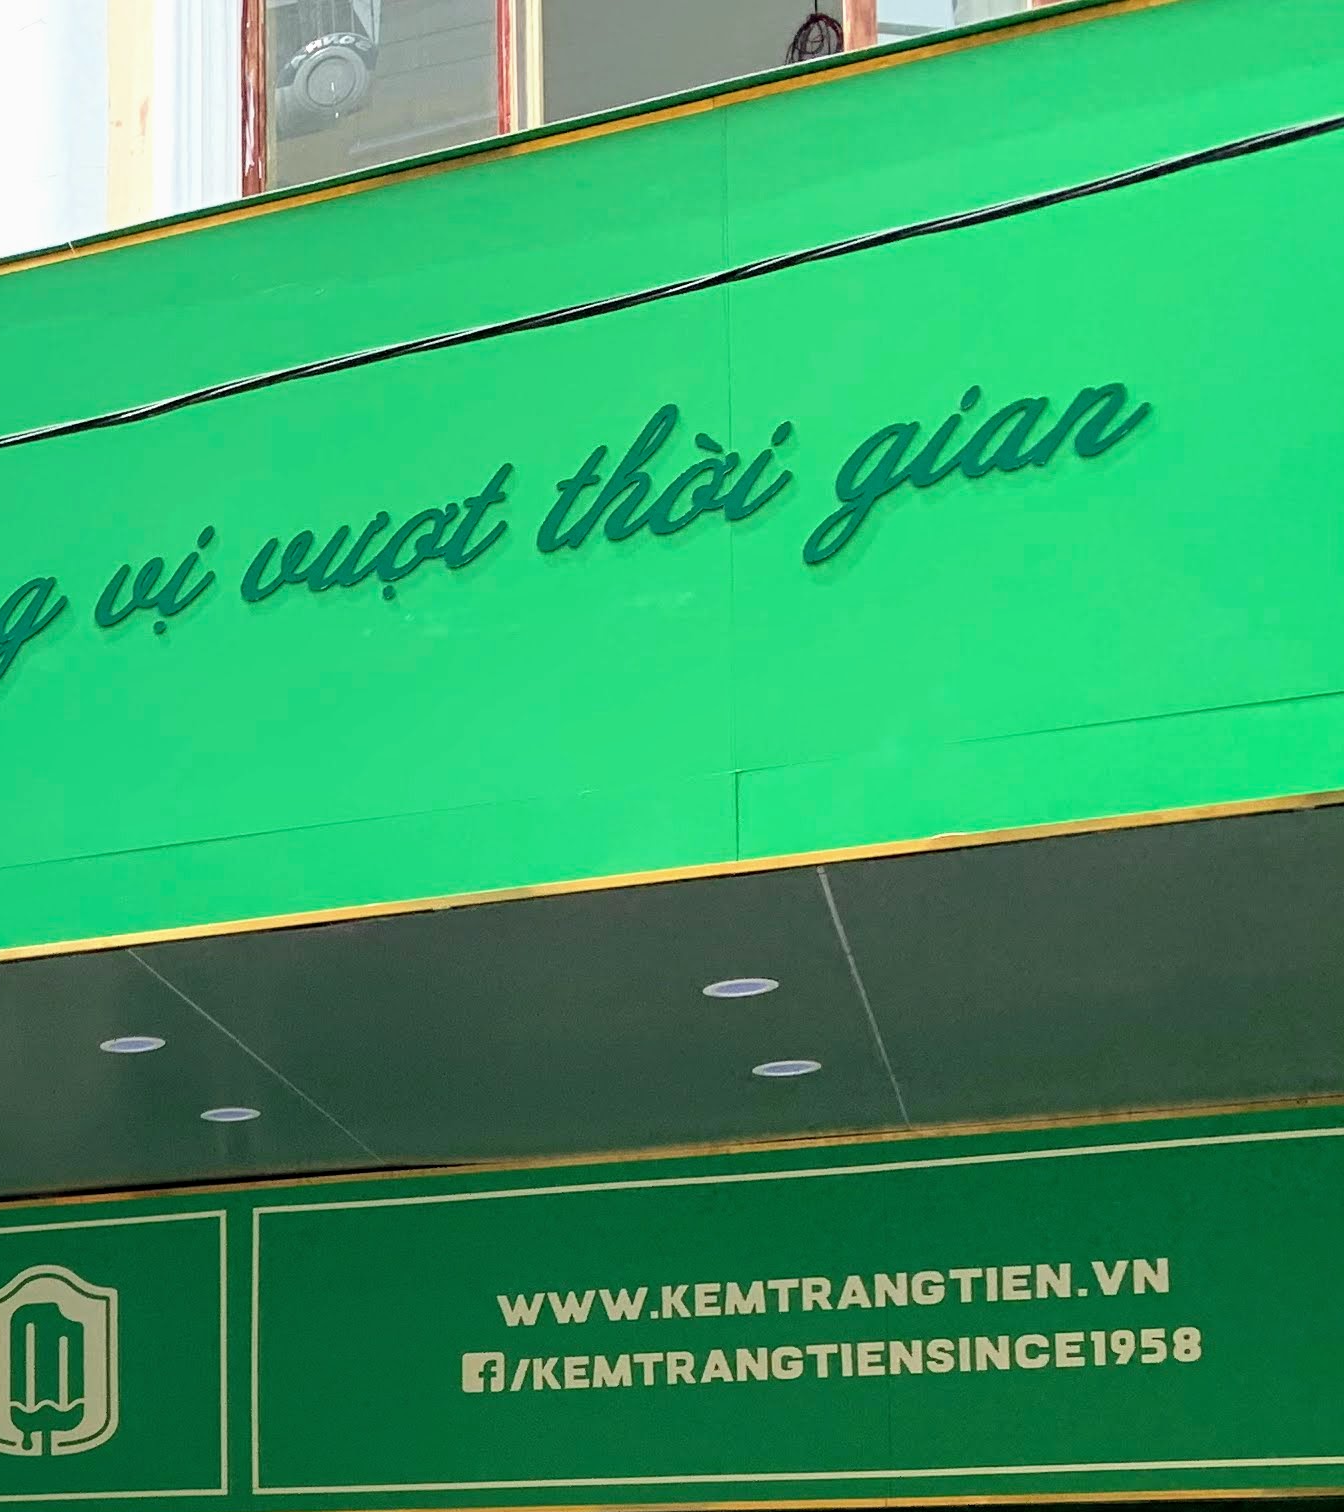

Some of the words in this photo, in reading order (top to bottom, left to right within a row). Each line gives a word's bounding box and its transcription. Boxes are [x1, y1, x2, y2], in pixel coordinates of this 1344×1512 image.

[93, 529, 211, 635] vị
[240, 463, 512, 602] vượt
[536, 403, 793, 551] thời
[803, 381, 1151, 564] gian
[496, 1257, 1170, 1328] WWW.KEMTRANGTIEN.VN
